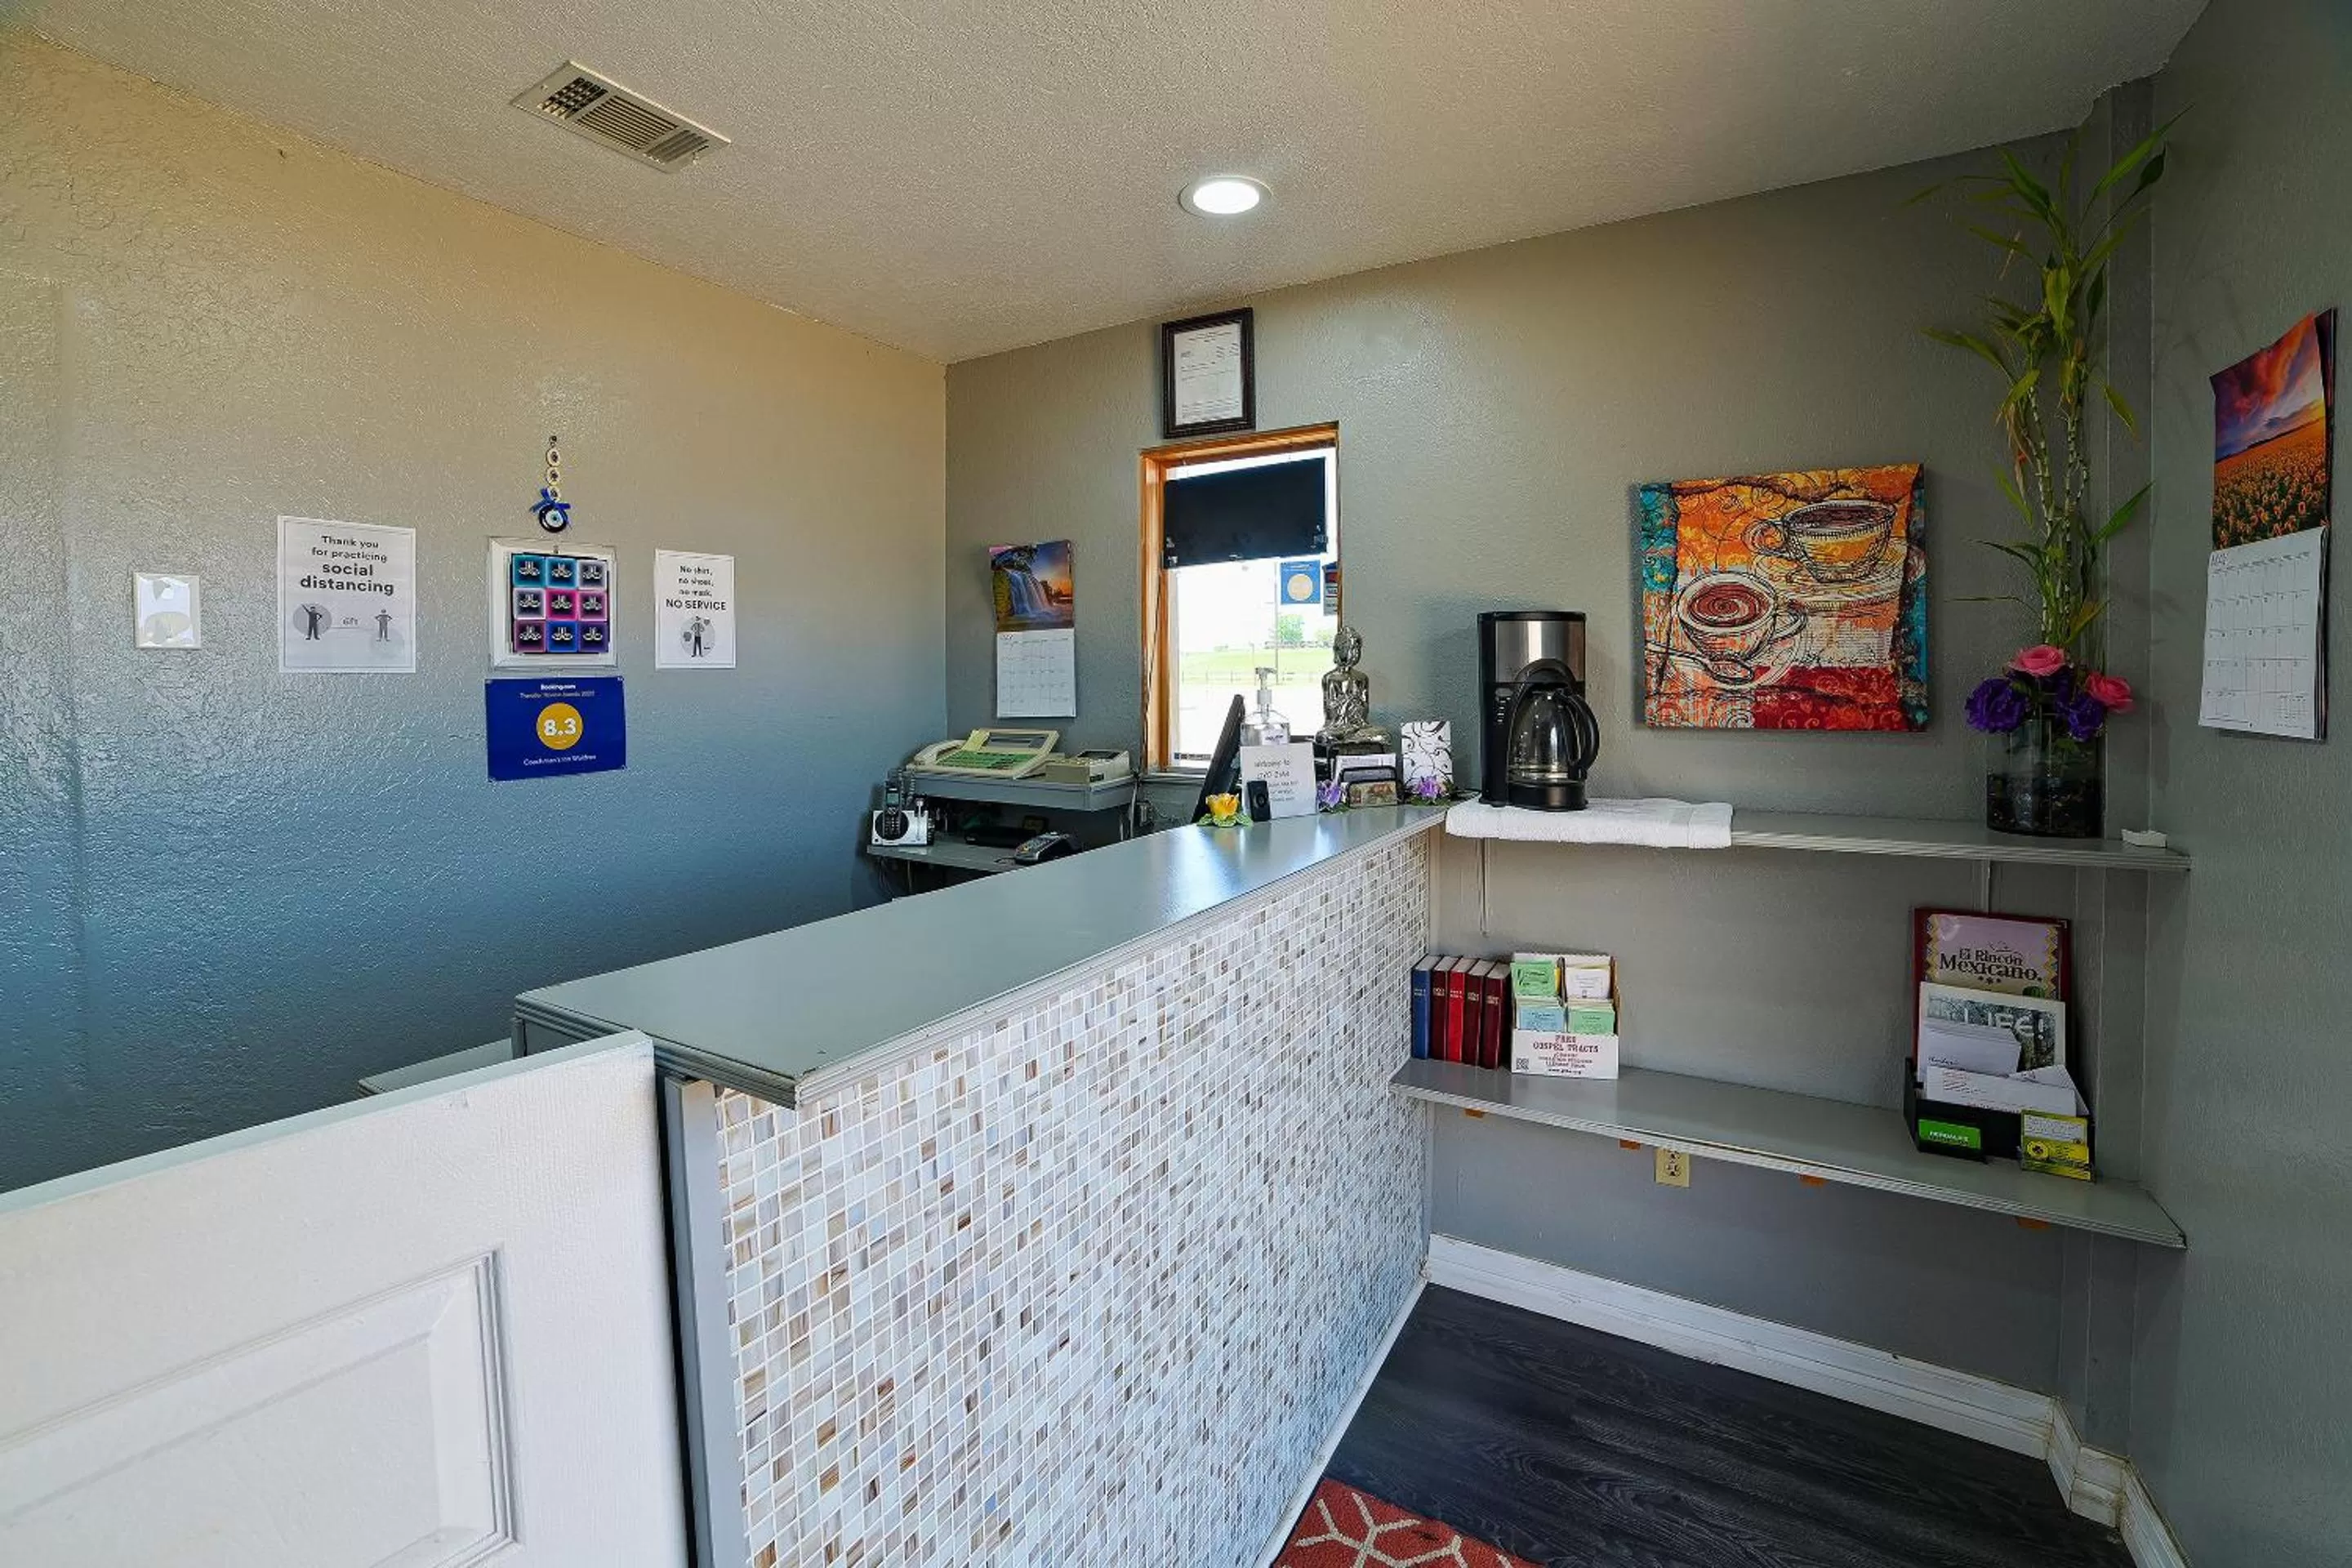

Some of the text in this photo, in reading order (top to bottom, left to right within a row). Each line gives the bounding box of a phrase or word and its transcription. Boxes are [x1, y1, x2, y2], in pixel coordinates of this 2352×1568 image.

[321, 536, 379, 549] Thank you
[311, 547, 387, 563] for practicing
[323, 563, 373, 577] social
[300, 575, 394, 596] distancing
[666, 599, 727, 611] NO SERVICE
[543, 717, 577, 737] 8.3
[1939, 952, 2038, 981] Mexicano
